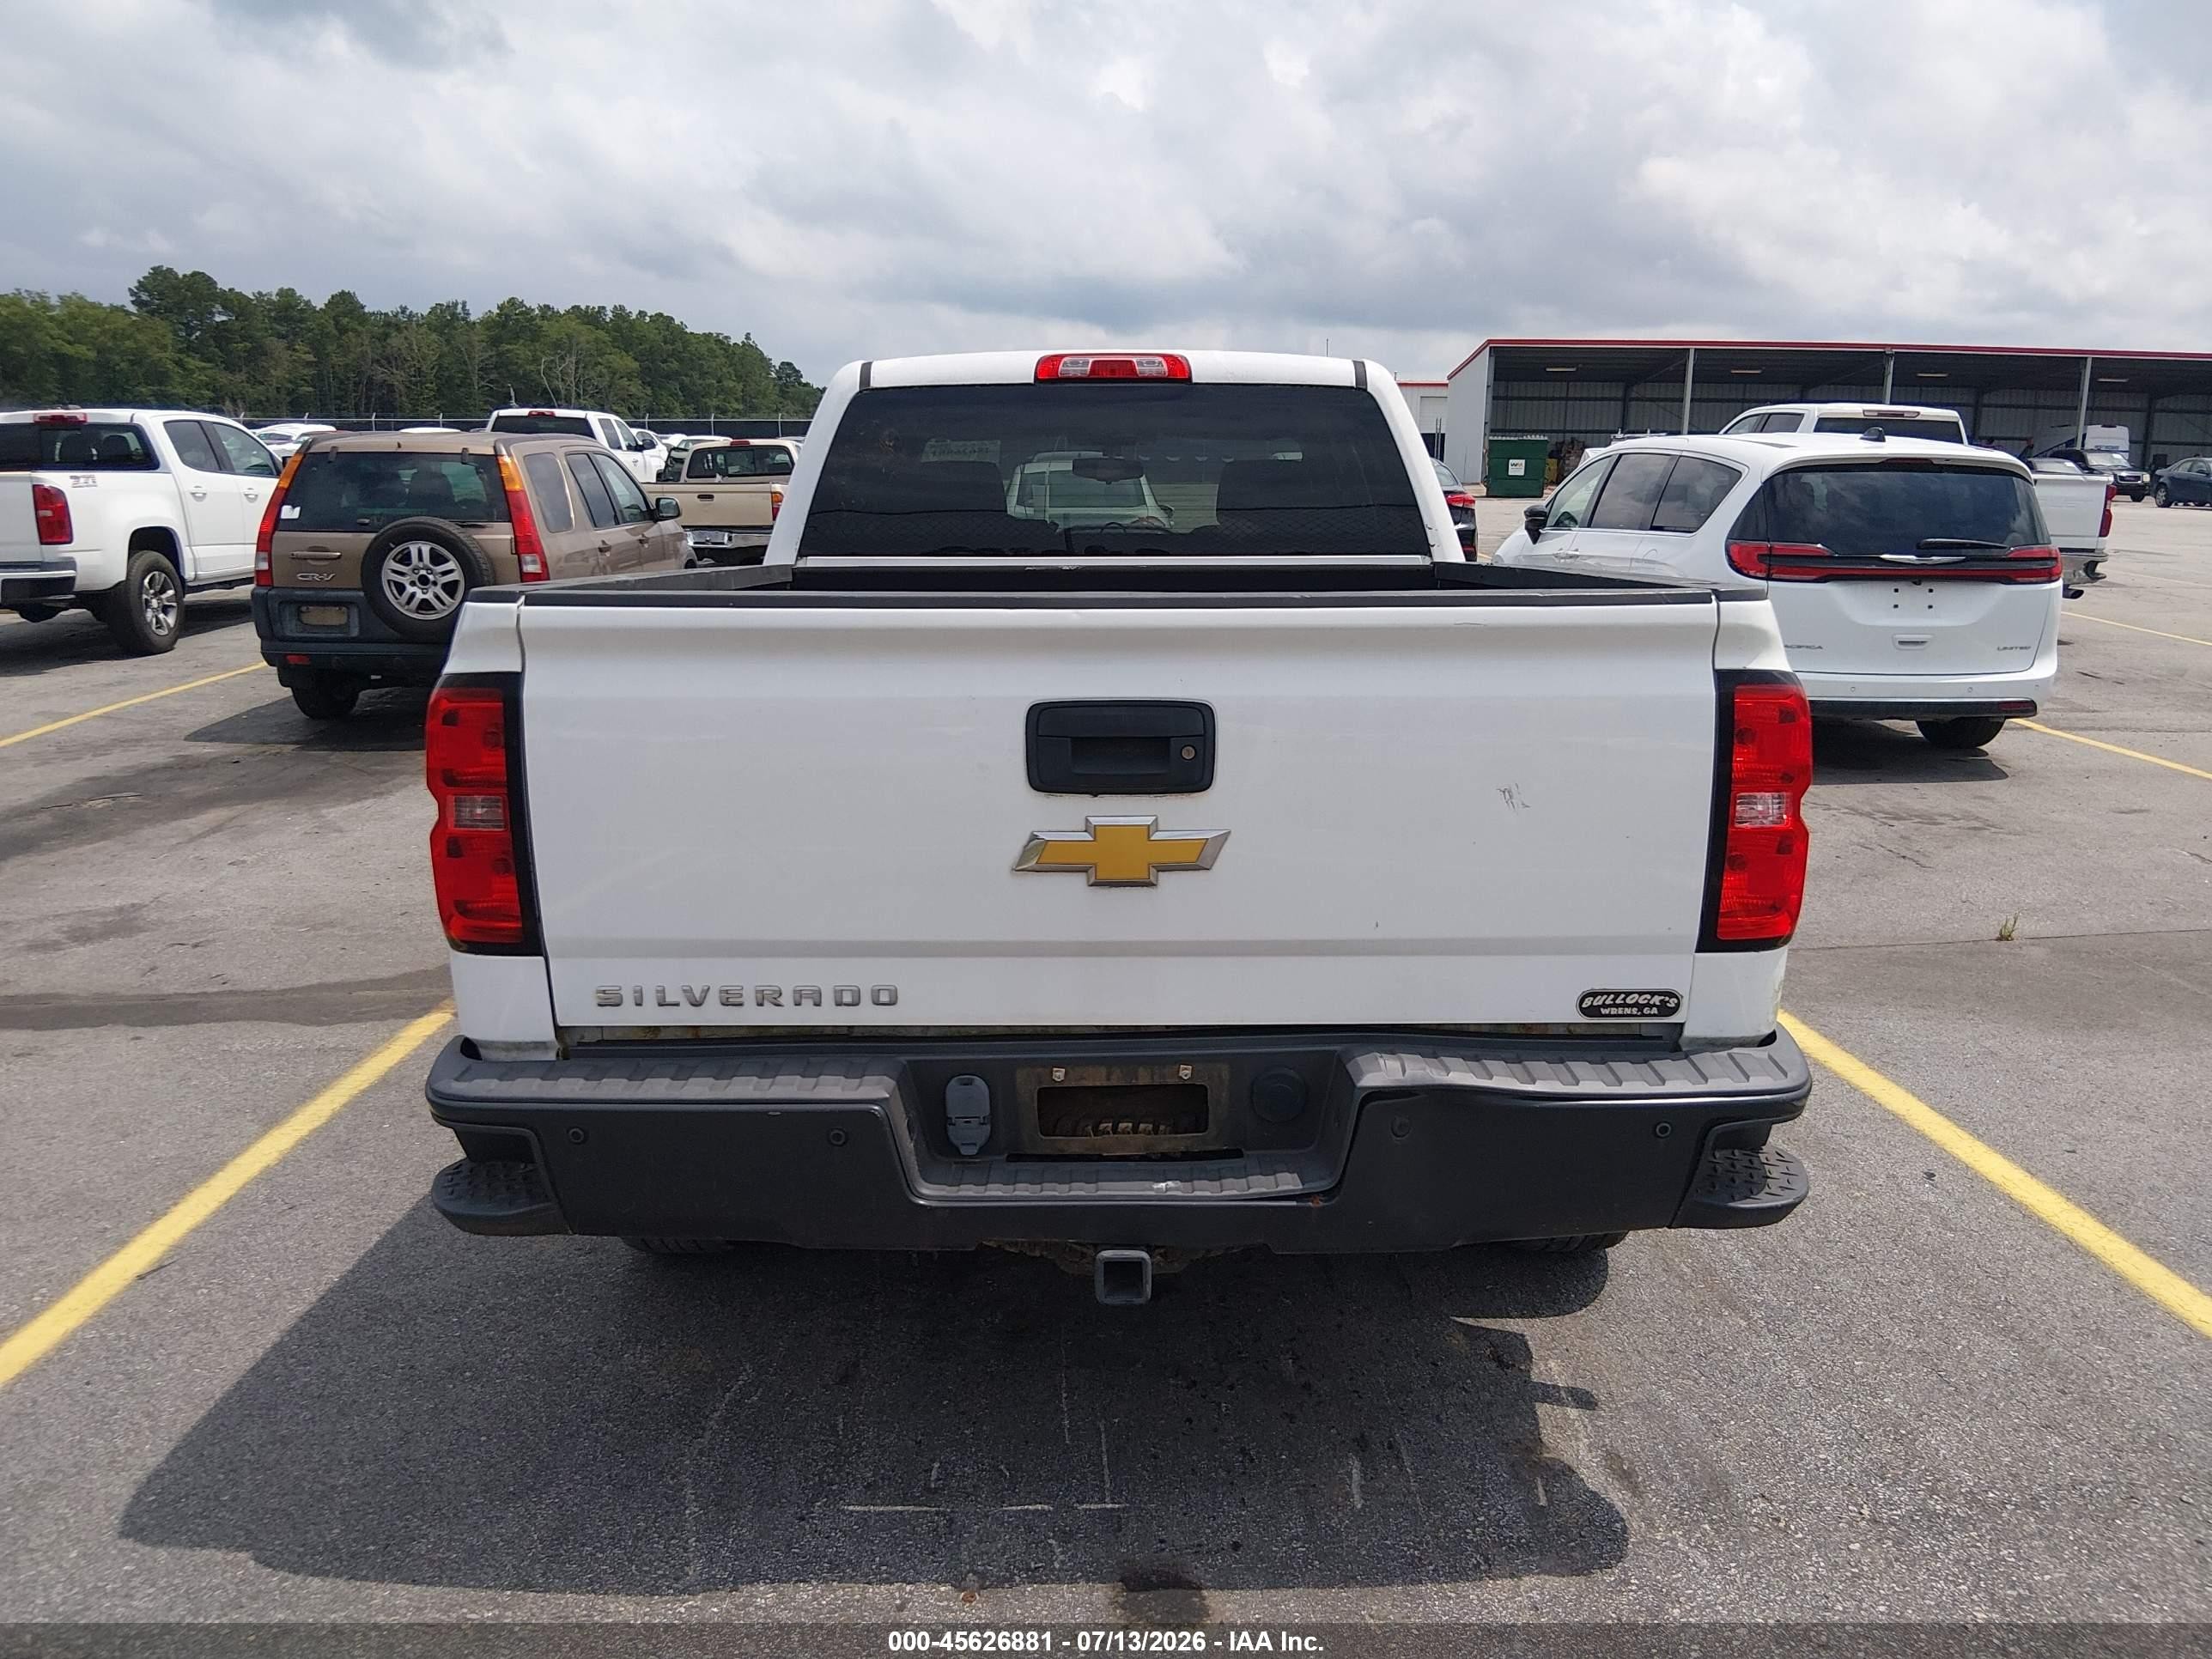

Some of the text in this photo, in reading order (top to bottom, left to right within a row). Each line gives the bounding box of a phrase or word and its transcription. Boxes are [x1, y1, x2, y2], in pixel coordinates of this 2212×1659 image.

[296, 573, 336, 581] CR-V
[596, 984, 899, 1007] SILVERADO
[1581, 994, 1678, 1008] BULLOCK'S
[1601, 1006, 1658, 1016] WRENS, GA
